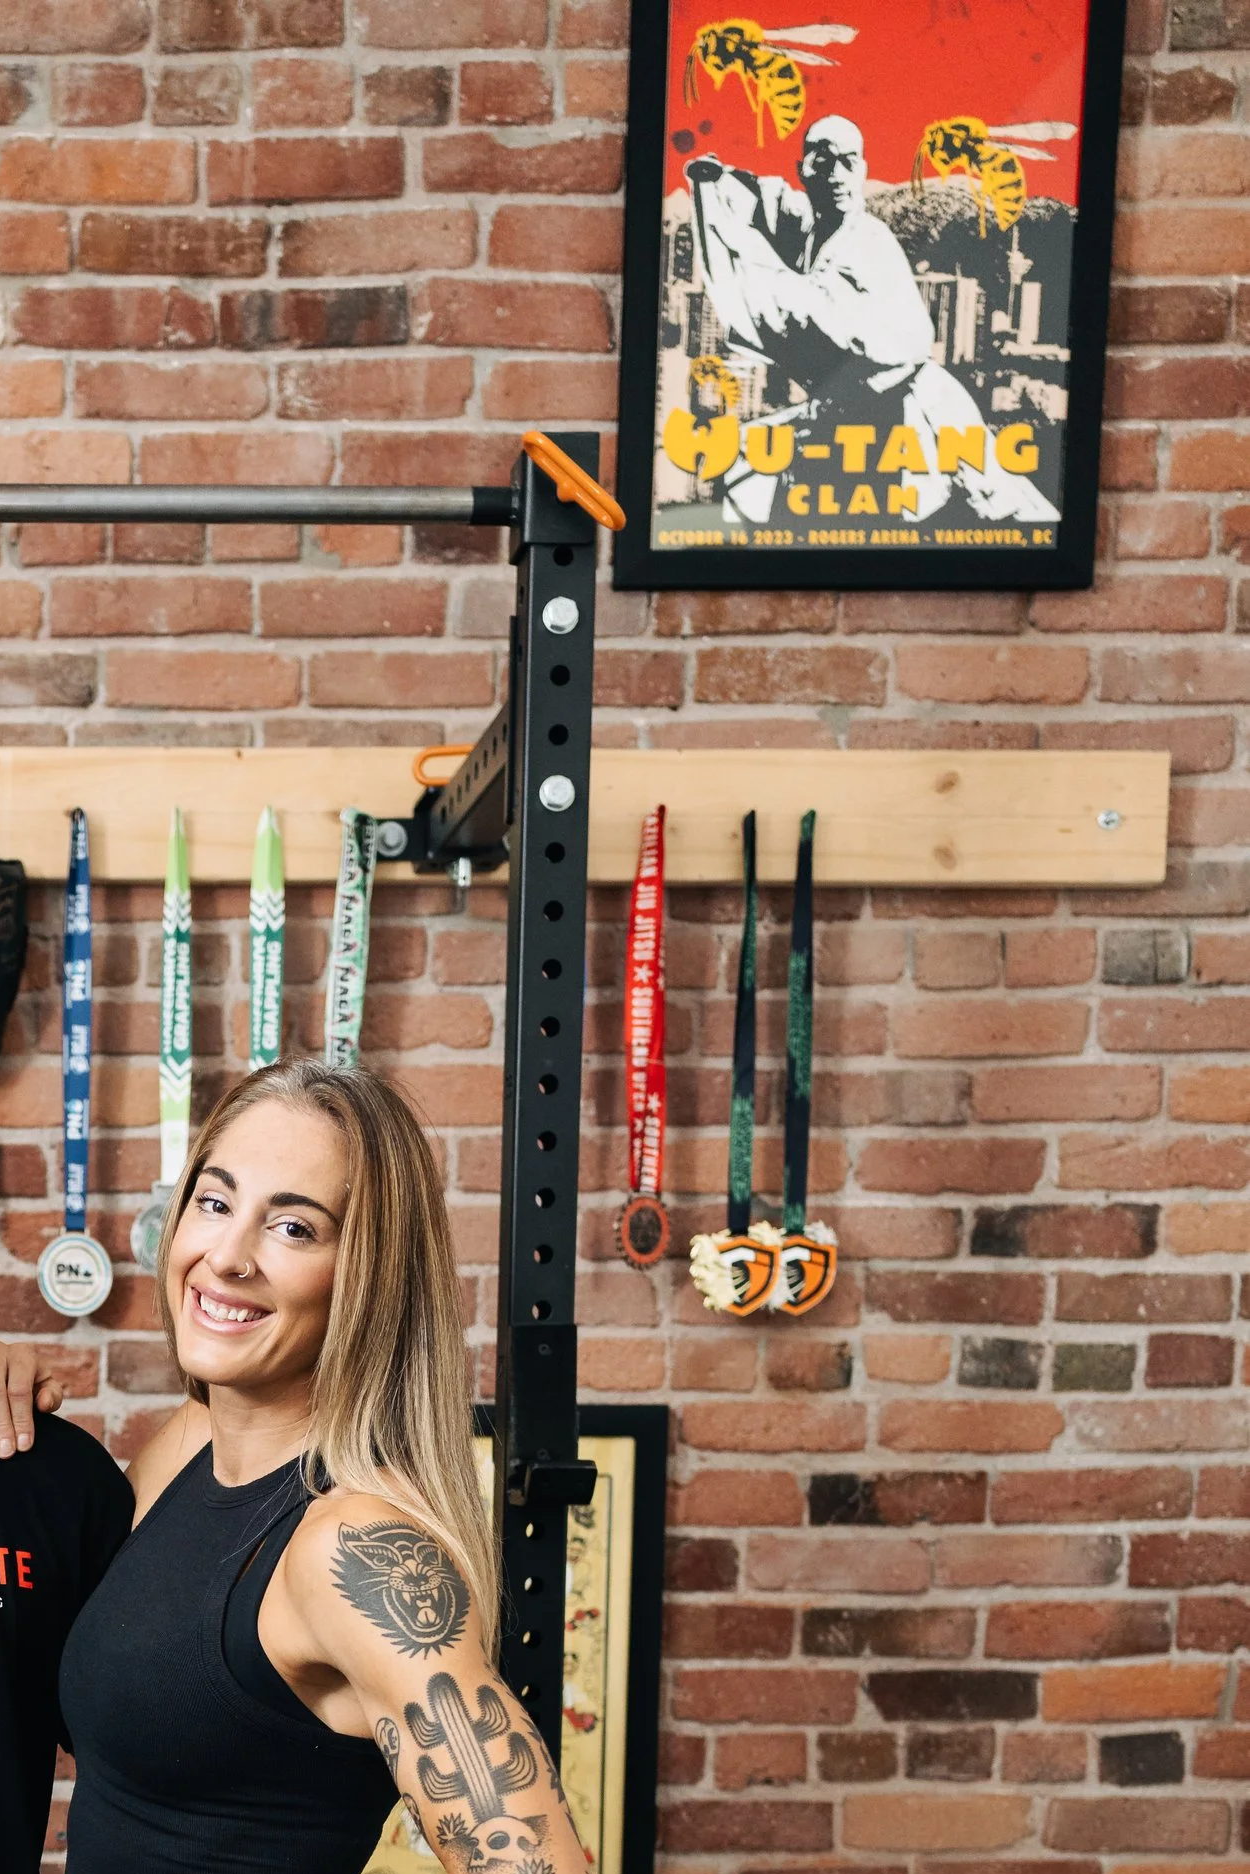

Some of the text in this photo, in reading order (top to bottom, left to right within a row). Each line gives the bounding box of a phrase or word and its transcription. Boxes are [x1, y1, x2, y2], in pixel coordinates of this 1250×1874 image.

[663, 407, 1040, 482] WU-TANG
[786, 484, 919, 516] CLAN
[658, 529, 725, 546] OCTOBER
[729, 529, 749, 546] 16
[753, 529, 794, 546] 2023
[808, 529, 866, 545] ROGERS
[870, 529, 920, 545] ARENA
[934, 529, 1029, 547] VANCOUVER,
[1032, 528, 1053, 545] BC
[632, 914, 656, 961] JITSU
[172, 941, 191, 1052] GRAPPLING
[261, 940, 281, 1051] GRAPPLING
